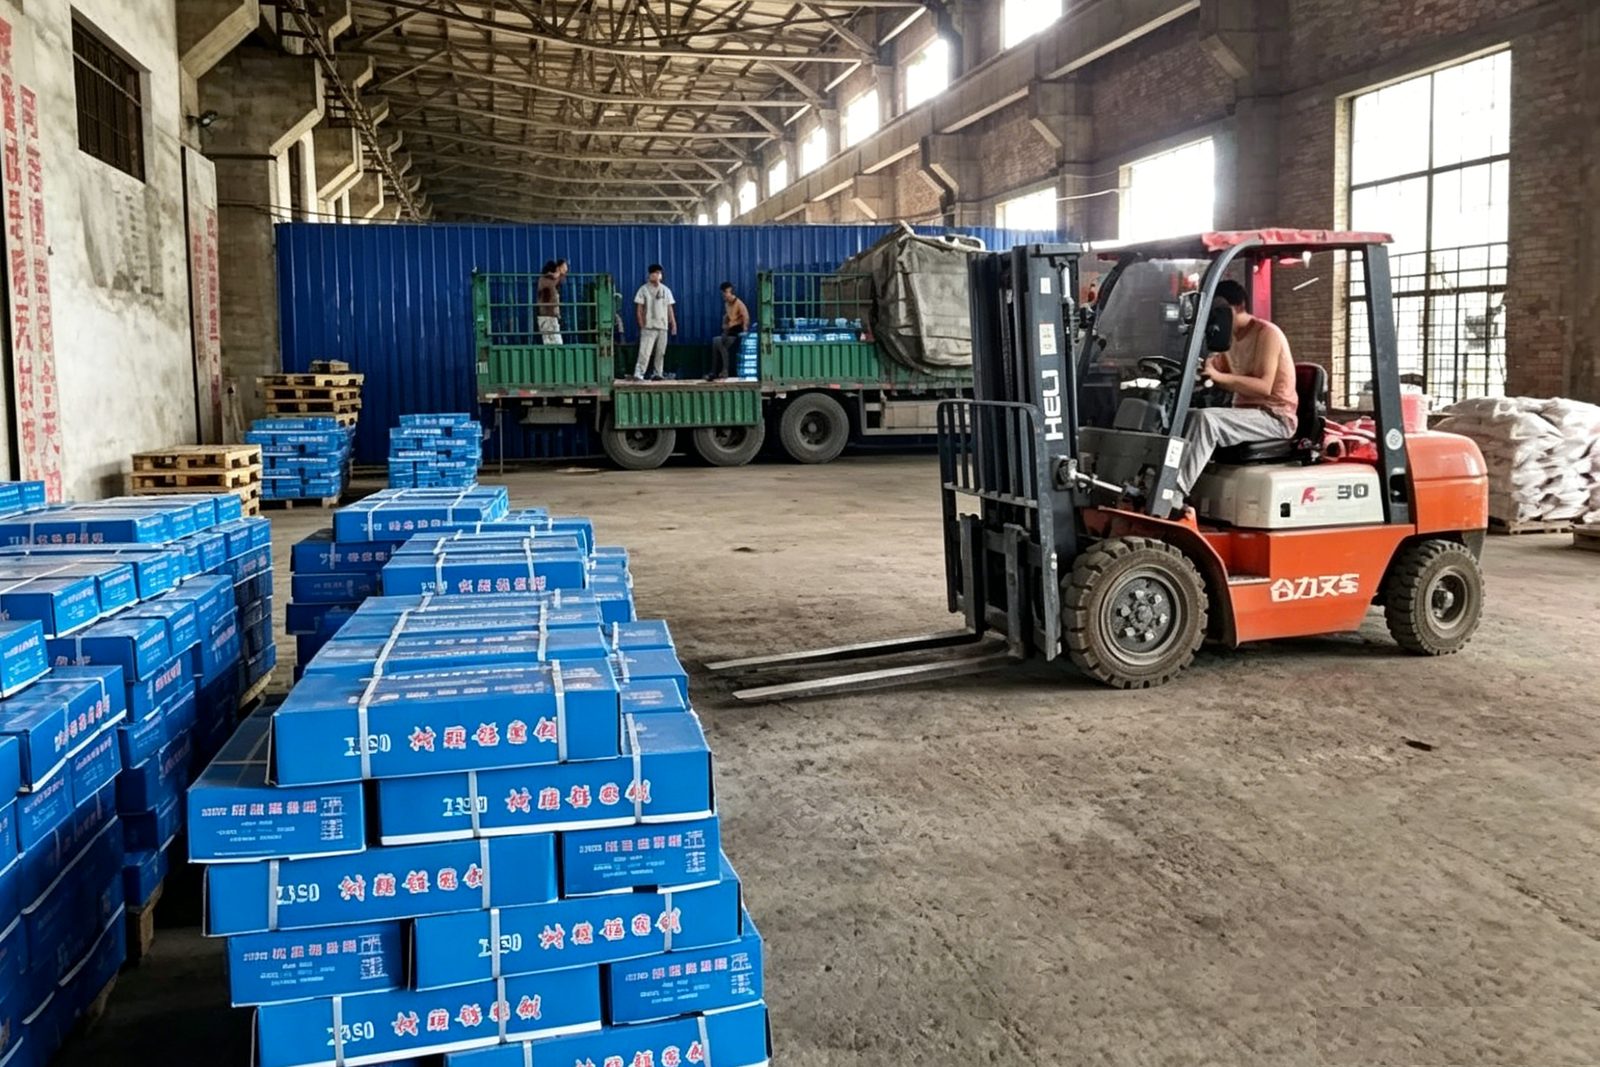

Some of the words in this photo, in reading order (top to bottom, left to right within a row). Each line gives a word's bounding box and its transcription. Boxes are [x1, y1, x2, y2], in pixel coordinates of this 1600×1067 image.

[1041, 370, 1065, 441] HELI
[1337, 484, 1369, 500] 30
[1270, 573, 1360, 602] 合力叉车
